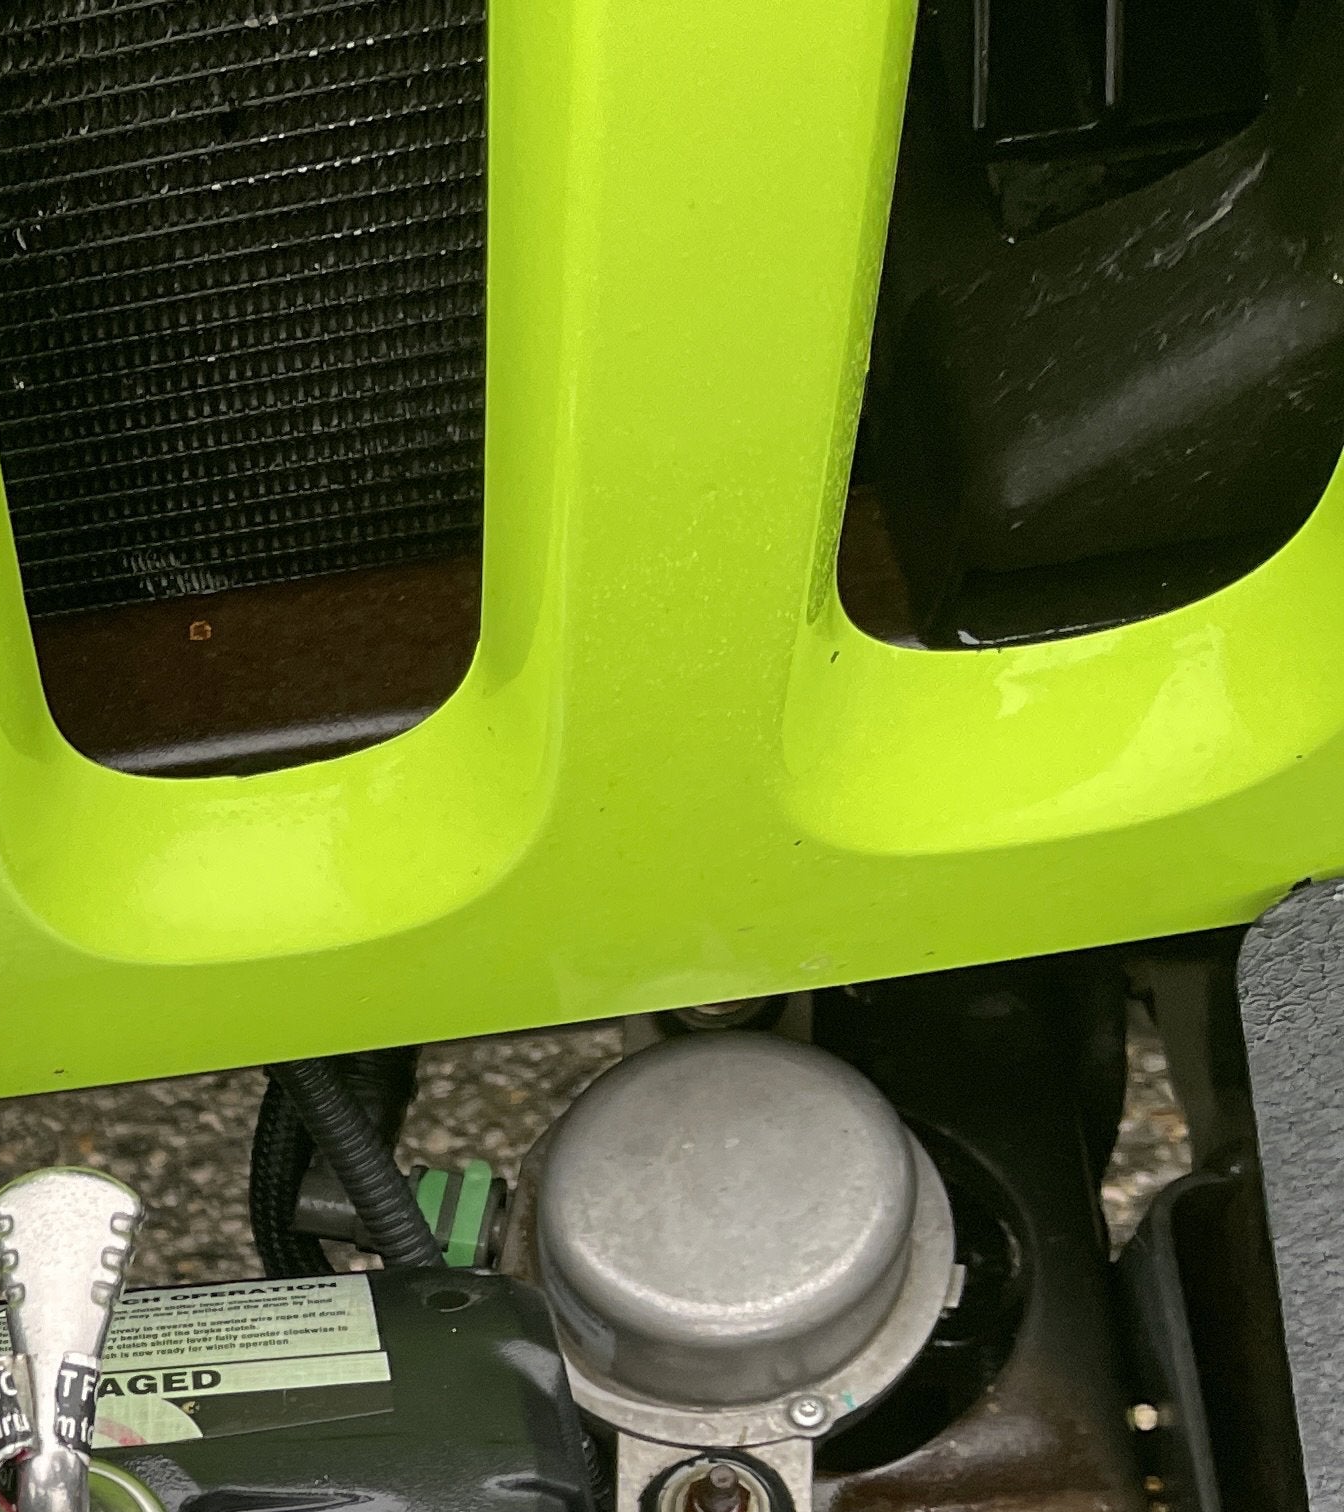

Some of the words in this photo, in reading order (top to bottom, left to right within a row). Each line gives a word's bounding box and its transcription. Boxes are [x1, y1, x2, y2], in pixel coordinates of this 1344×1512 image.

[171, 1282, 337, 1301] OPERATION
[156, 1322, 194, 1331] reverse
[210, 1317, 247, 1326] unwind
[250, 1315, 272, 1323] wire
[276, 1314, 299, 1322] rope
[193, 1327, 222, 1335] brake
[116, 1342, 148, 1350] clutch
[151, 1339, 183, 1348] shifter
[186, 1336, 212, 1344] lever
[215, 1333, 238, 1342] fully
[241, 1330, 281, 1340] counter
[283, 1326, 335, 1337] clockwise
[338, 1324, 349, 1332] to
[156, 1347, 185, 1356] ready
[205, 1341, 236, 1351] winch
